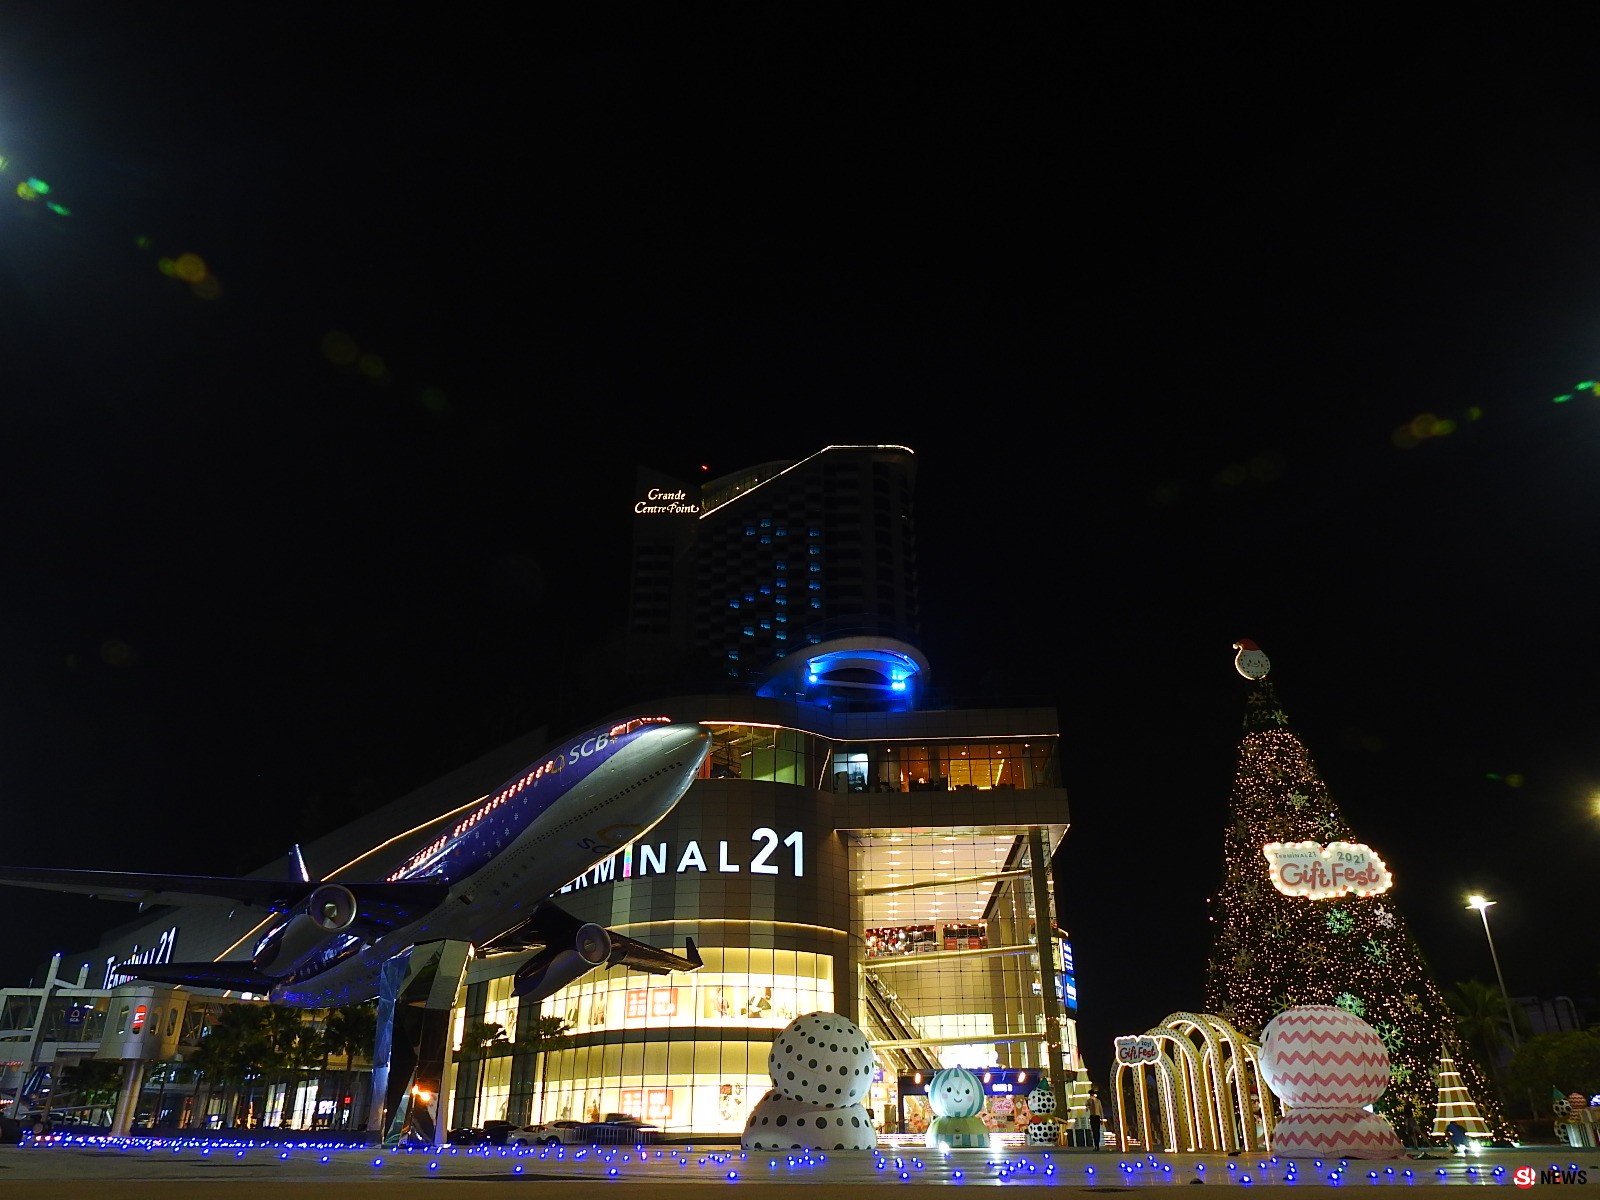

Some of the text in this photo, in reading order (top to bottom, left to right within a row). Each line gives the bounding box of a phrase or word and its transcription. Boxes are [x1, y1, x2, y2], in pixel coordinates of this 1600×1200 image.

[647, 488, 686, 500] Grande
[568, 733, 609, 765] SCB
[1337, 851, 1365, 863] 2021
[1280, 860, 1380, 889] Gift Fest
[1120, 1046, 1156, 1060] Gift Fest
